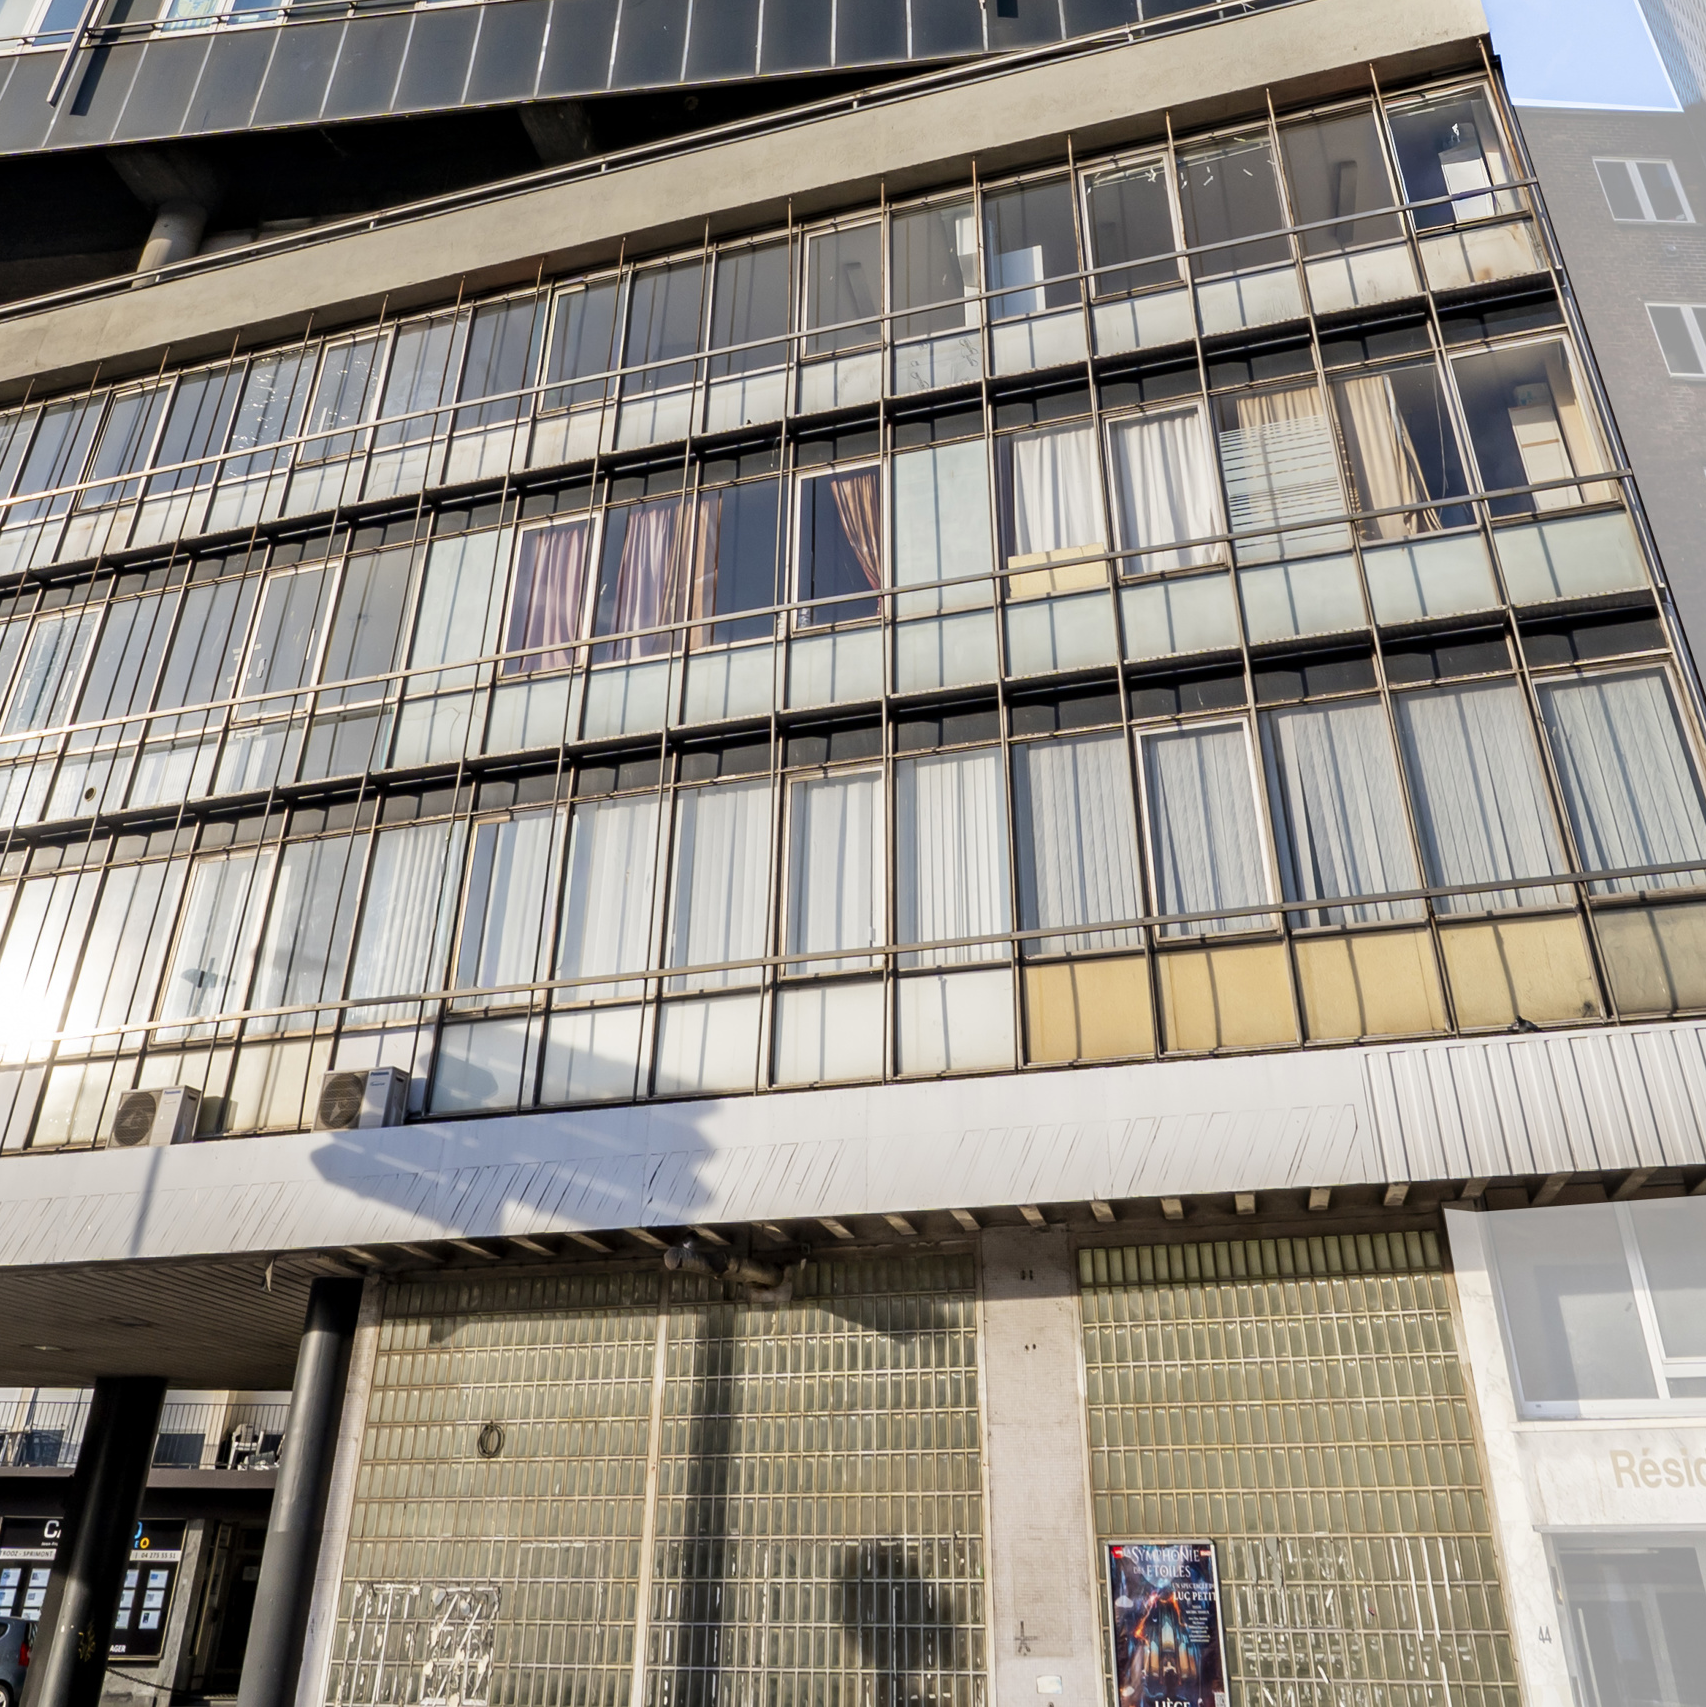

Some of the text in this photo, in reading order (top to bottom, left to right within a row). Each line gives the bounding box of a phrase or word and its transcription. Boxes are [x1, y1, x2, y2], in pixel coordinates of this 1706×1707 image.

[22, 1550, 54, 1558] SPRIMONT
[1131, 1545, 1200, 1564] SYMPHONIE
[1146, 1565, 1191, 1578] ETOILES
[1173, 1591, 1216, 1601] LUC PETIT
[1538, 1625, 1552, 1644] 44
[109, 1644, 127, 1653] AGER
